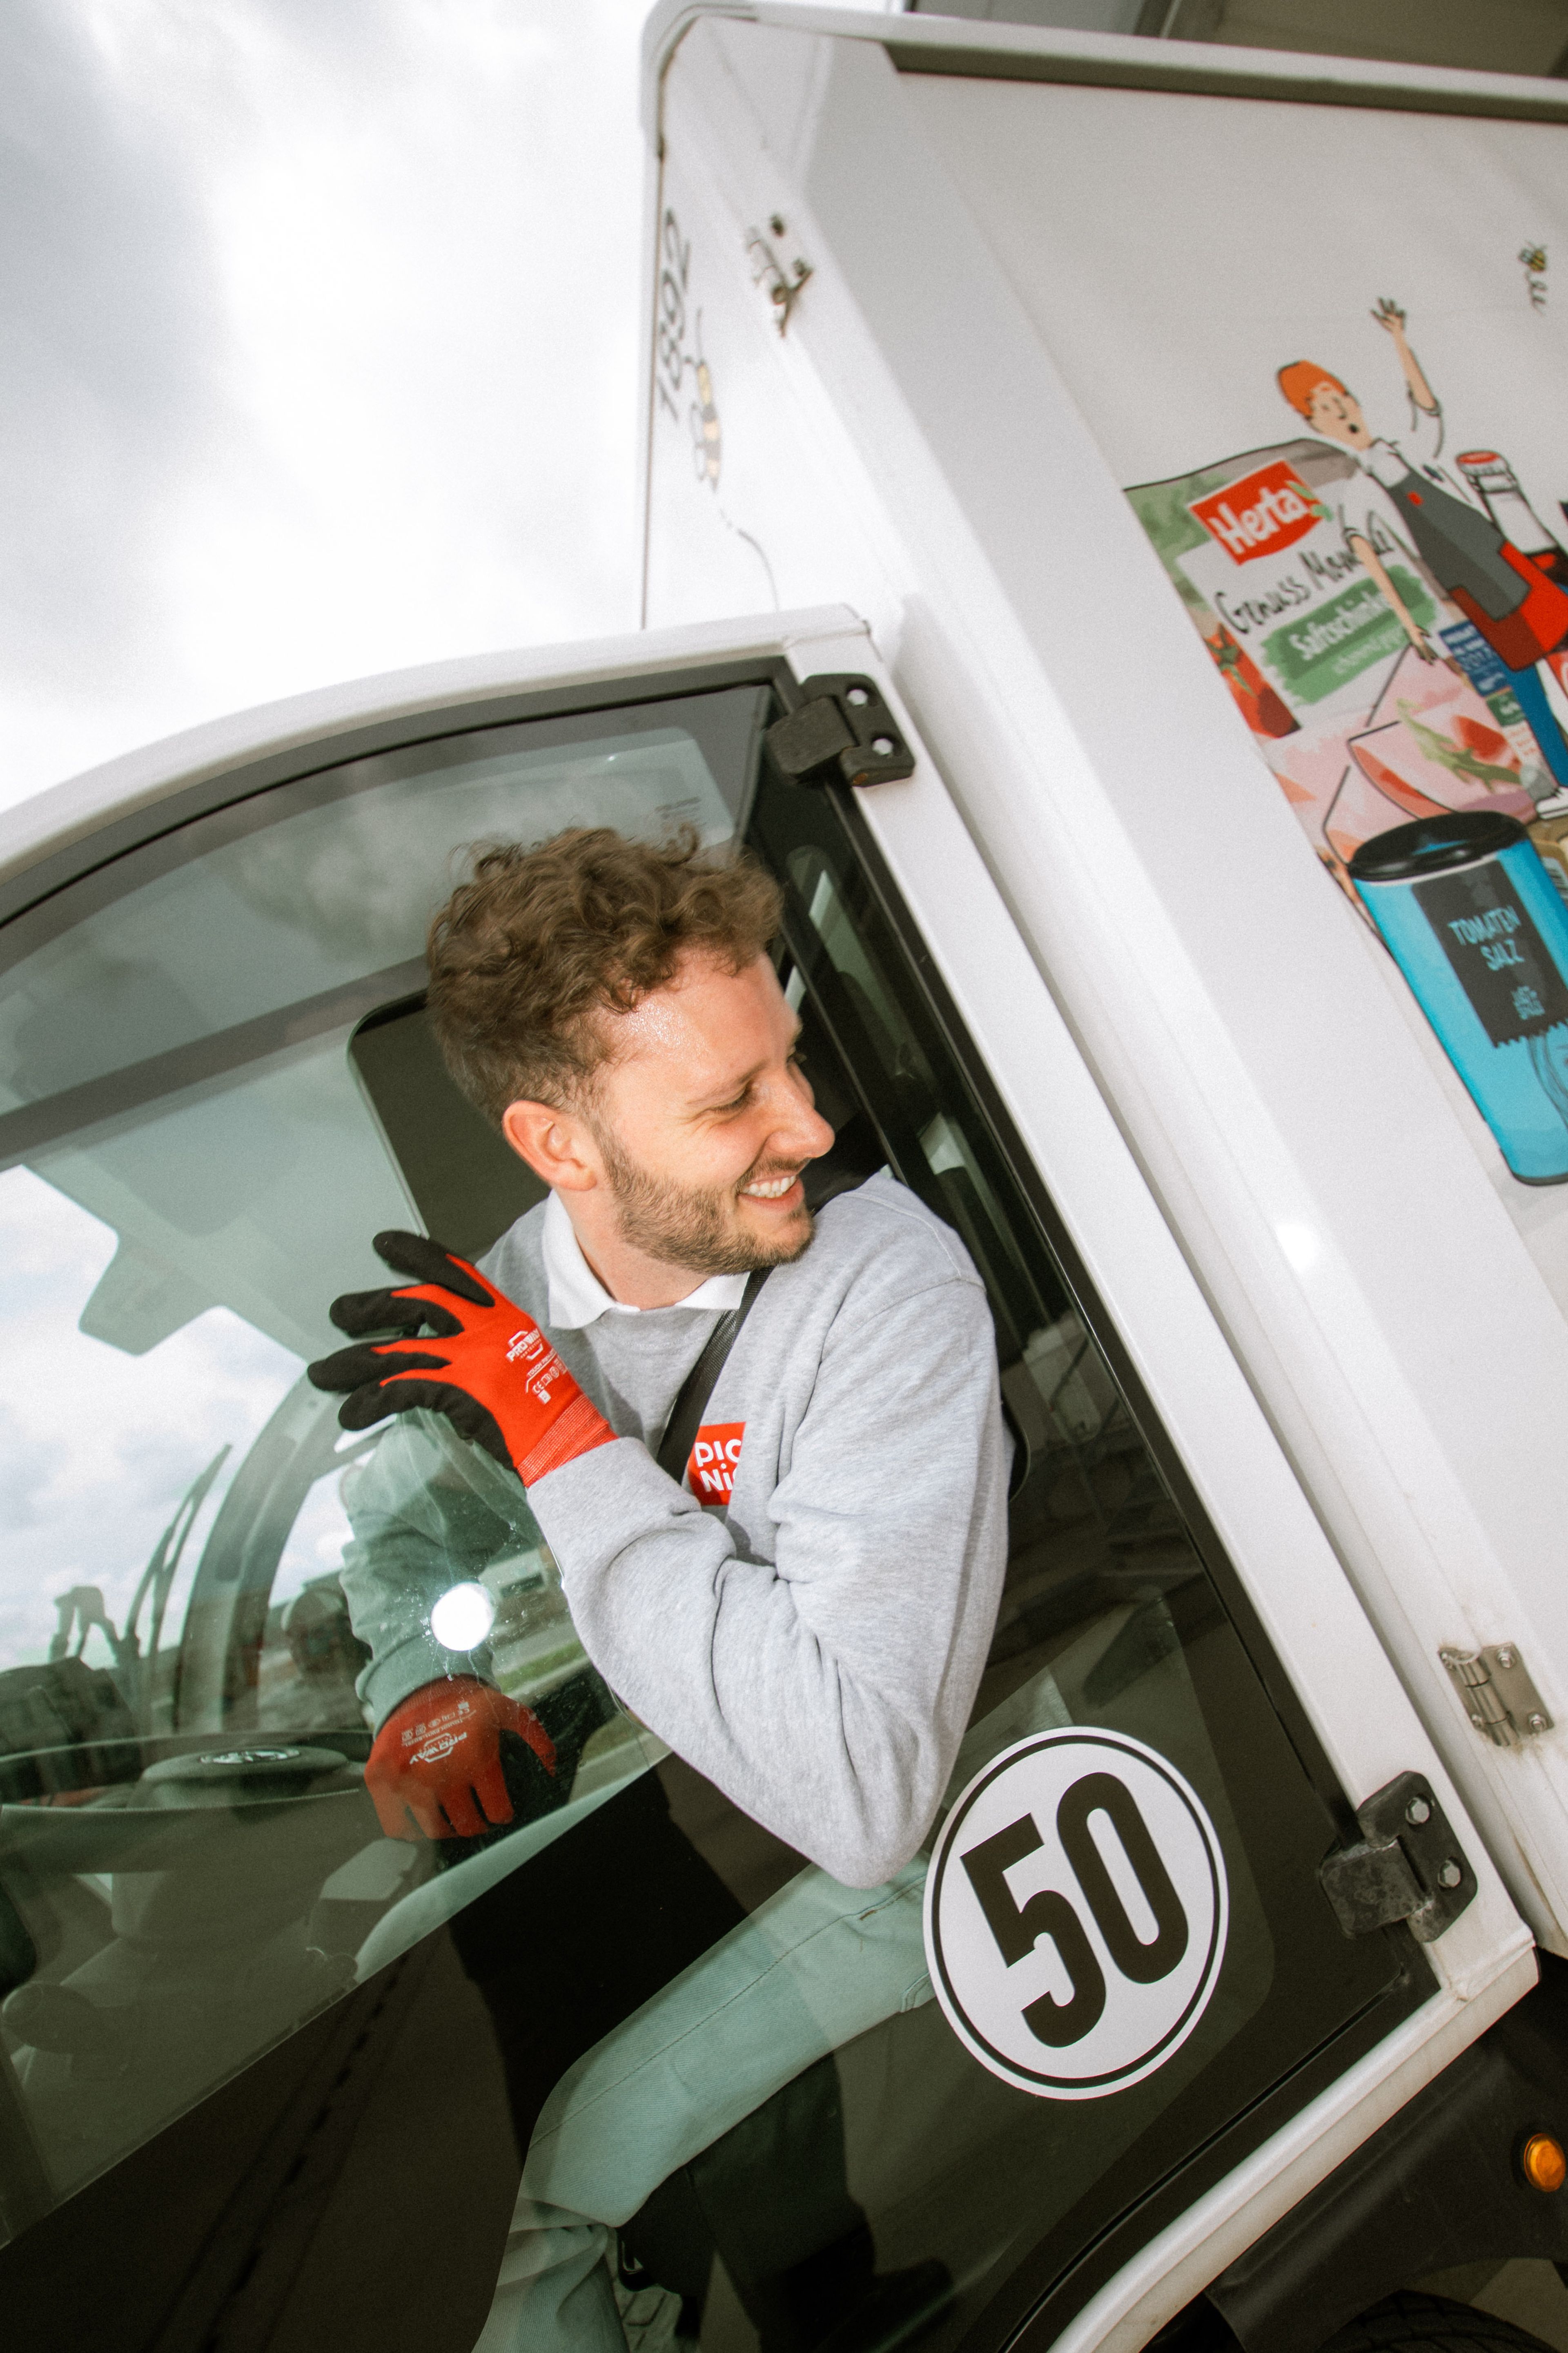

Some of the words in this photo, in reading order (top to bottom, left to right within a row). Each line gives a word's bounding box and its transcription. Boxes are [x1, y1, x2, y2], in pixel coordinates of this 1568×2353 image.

[1208, 487, 1310, 554] Herta
[1215, 576, 1311, 634] Genuss
[1480, 938, 1525, 971] SALZ
[960, 1772, 1189, 2048] 50
